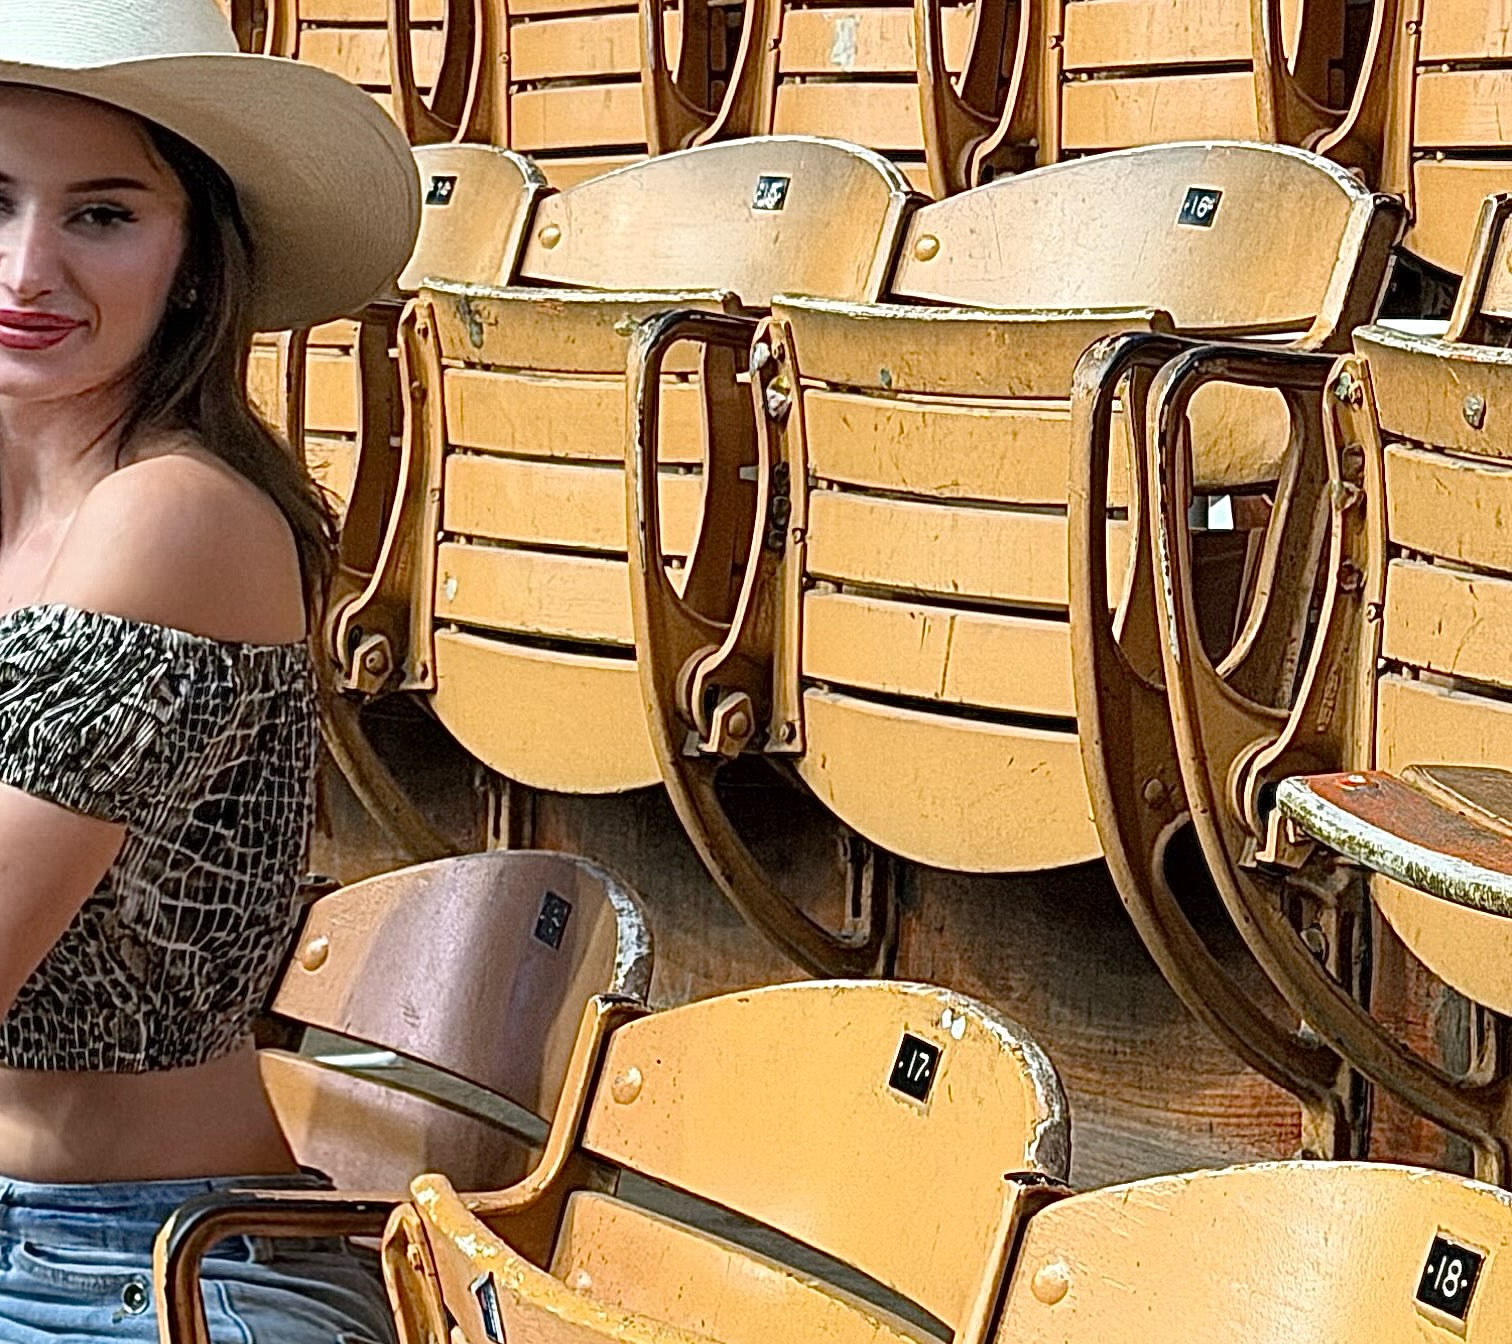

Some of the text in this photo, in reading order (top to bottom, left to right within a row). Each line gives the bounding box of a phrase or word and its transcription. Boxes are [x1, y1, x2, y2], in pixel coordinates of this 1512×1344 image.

[1190, 195, 1210, 218] 16
[906, 1048, 930, 1082] 17
[1432, 1255, 1463, 1298] 18
